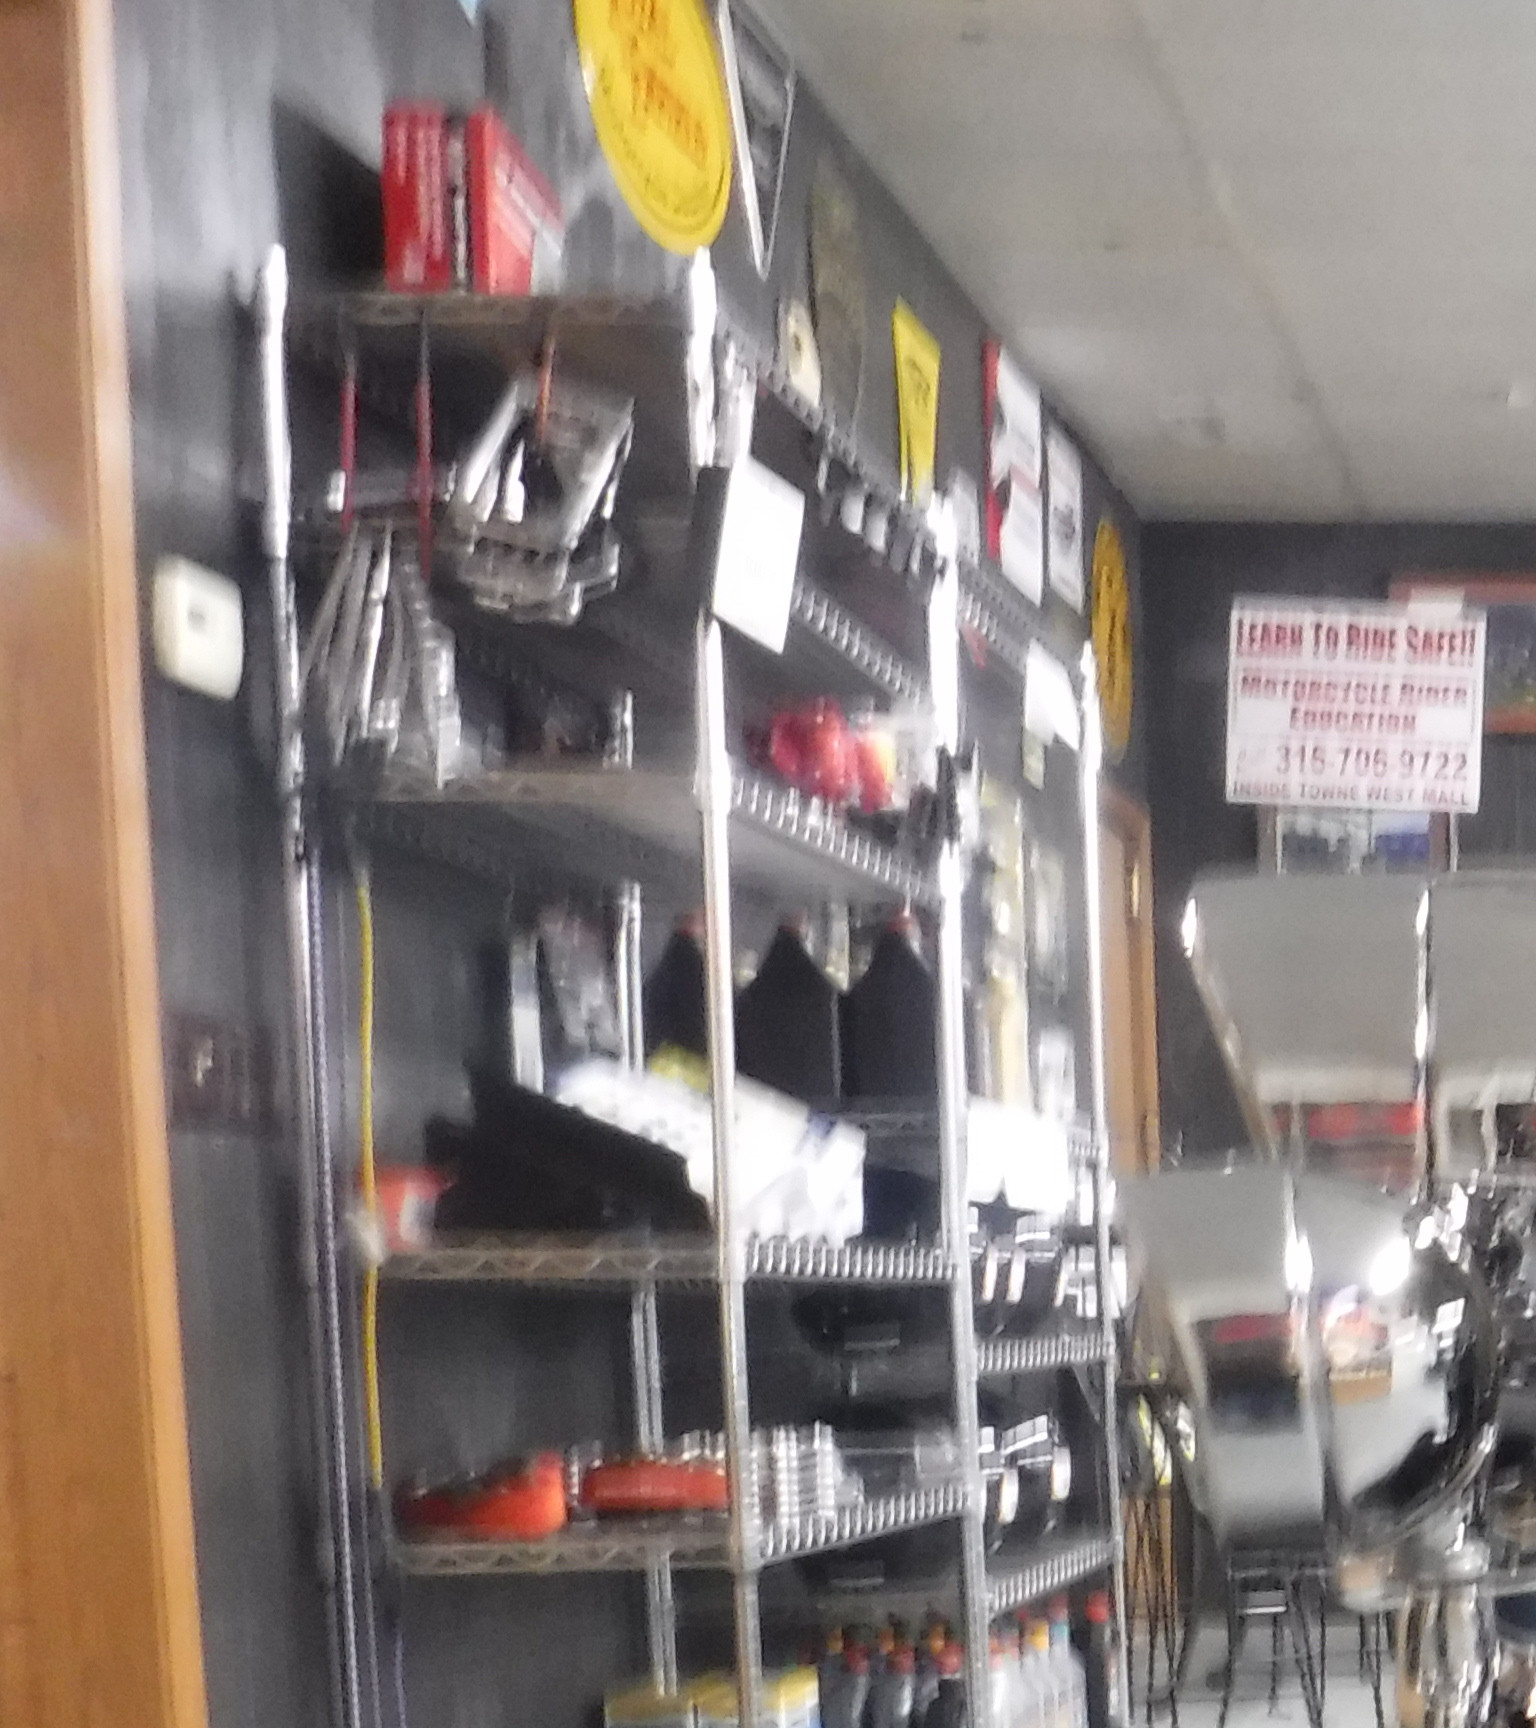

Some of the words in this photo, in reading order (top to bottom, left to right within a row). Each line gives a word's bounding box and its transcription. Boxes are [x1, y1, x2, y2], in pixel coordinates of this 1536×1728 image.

[1312, 622, 1338, 656] TO
[1240, 674, 1391, 702] MOTORCYCLE
[1290, 707, 1416, 733] EDUCATION
[1423, 786, 1469, 805] MALL
